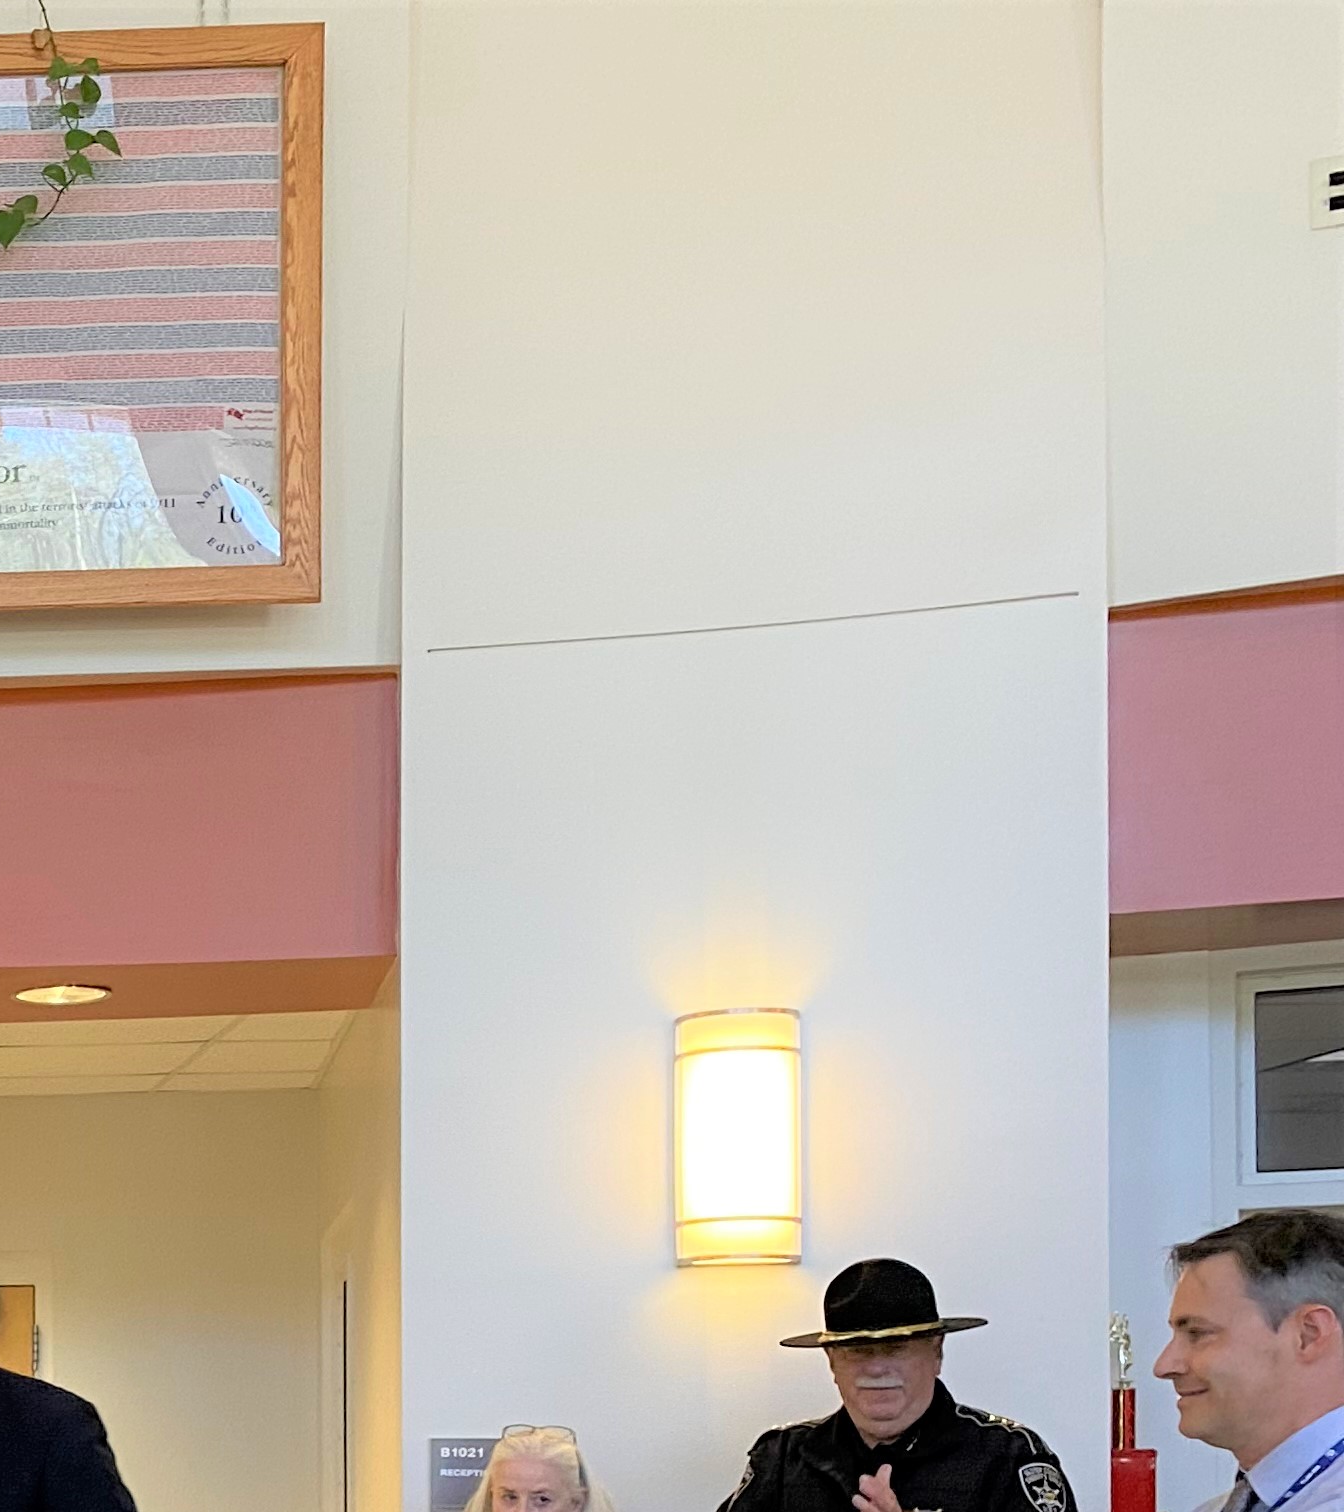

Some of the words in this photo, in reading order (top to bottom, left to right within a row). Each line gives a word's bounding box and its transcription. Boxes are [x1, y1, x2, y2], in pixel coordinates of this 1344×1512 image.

[196, 476, 273, 508] Anniersary
[440, 1447, 484, 1458] B1021
[440, 1468, 484, 1477] RECEPTI
